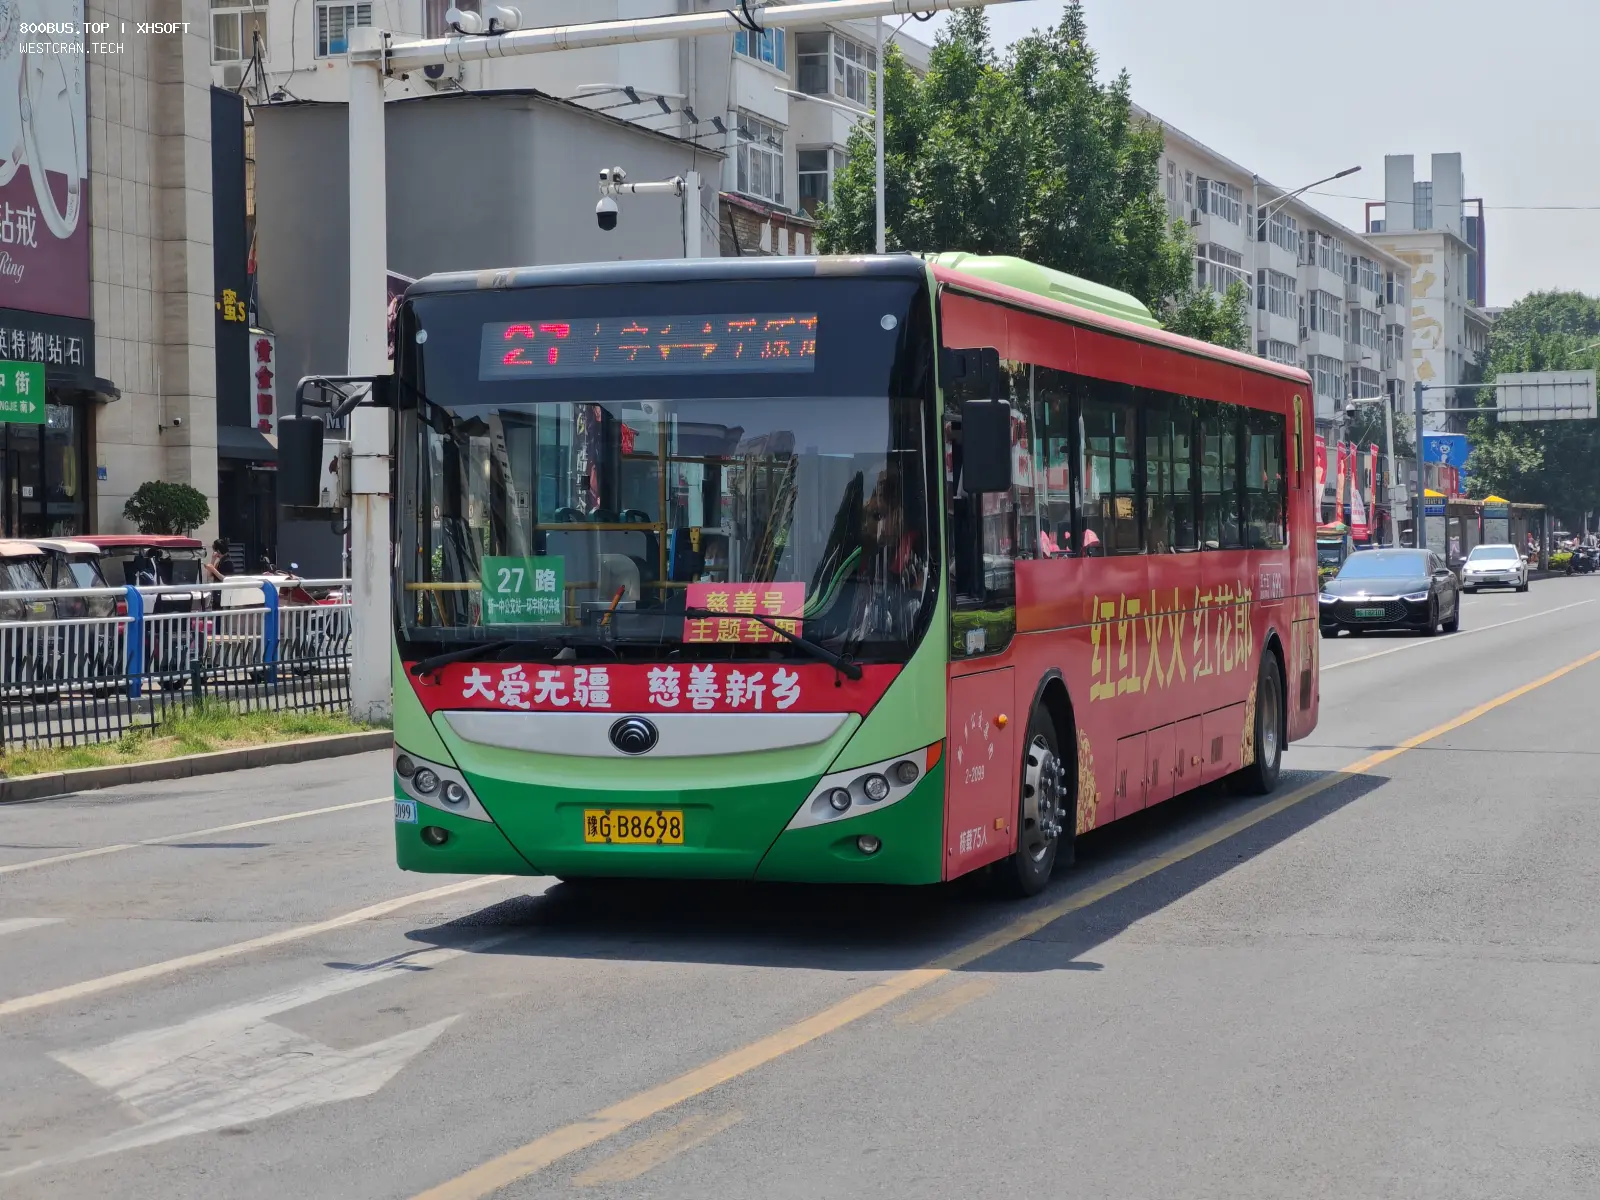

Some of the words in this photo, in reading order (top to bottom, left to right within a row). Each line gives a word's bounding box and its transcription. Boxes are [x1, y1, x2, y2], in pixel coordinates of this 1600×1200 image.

[20, 400, 28, 413] 南
[497, 568, 524, 593] 27
[535, 568, 556, 592] 路
[706, 591, 785, 615] 慈善号
[689, 618, 797, 643] 主题车厢
[1090, 587, 1187, 703] 红红火火
[1193, 580, 1254, 684] 红花郎
[463, 665, 612, 710] 大爱无疆
[647, 664, 801, 711] 慈善新乡
